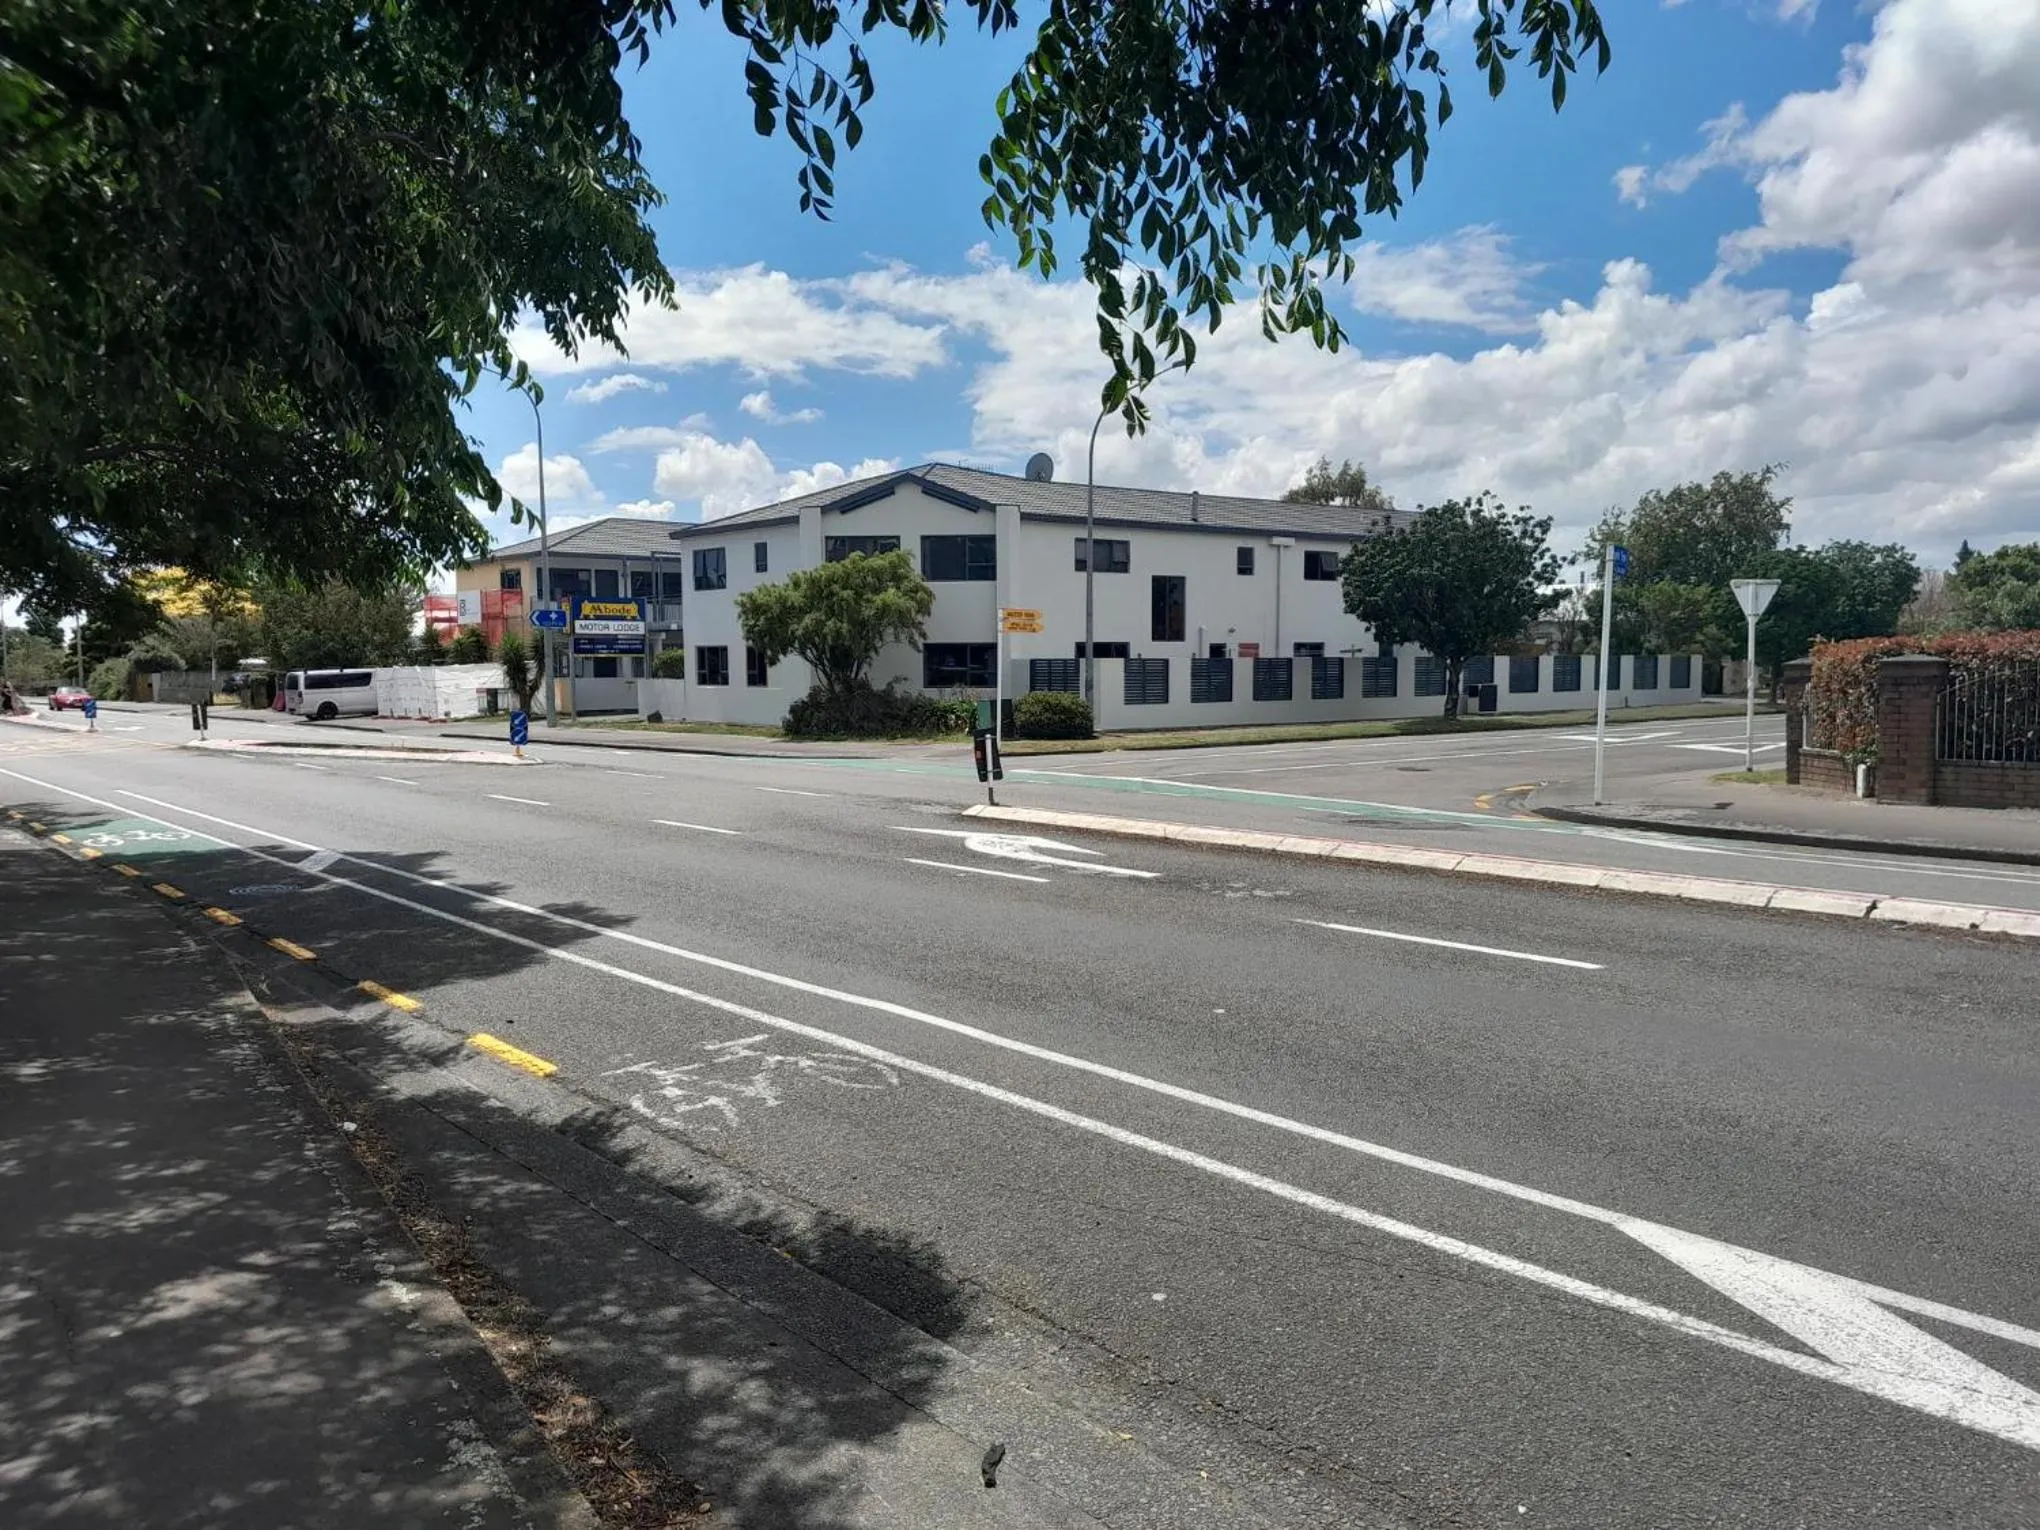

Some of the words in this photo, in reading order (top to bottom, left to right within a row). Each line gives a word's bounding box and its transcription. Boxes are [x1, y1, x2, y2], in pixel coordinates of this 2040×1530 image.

[589, 604, 633, 615] Abode
[579, 622, 610, 632] MOTOR
[613, 623, 641, 632] LODGE
